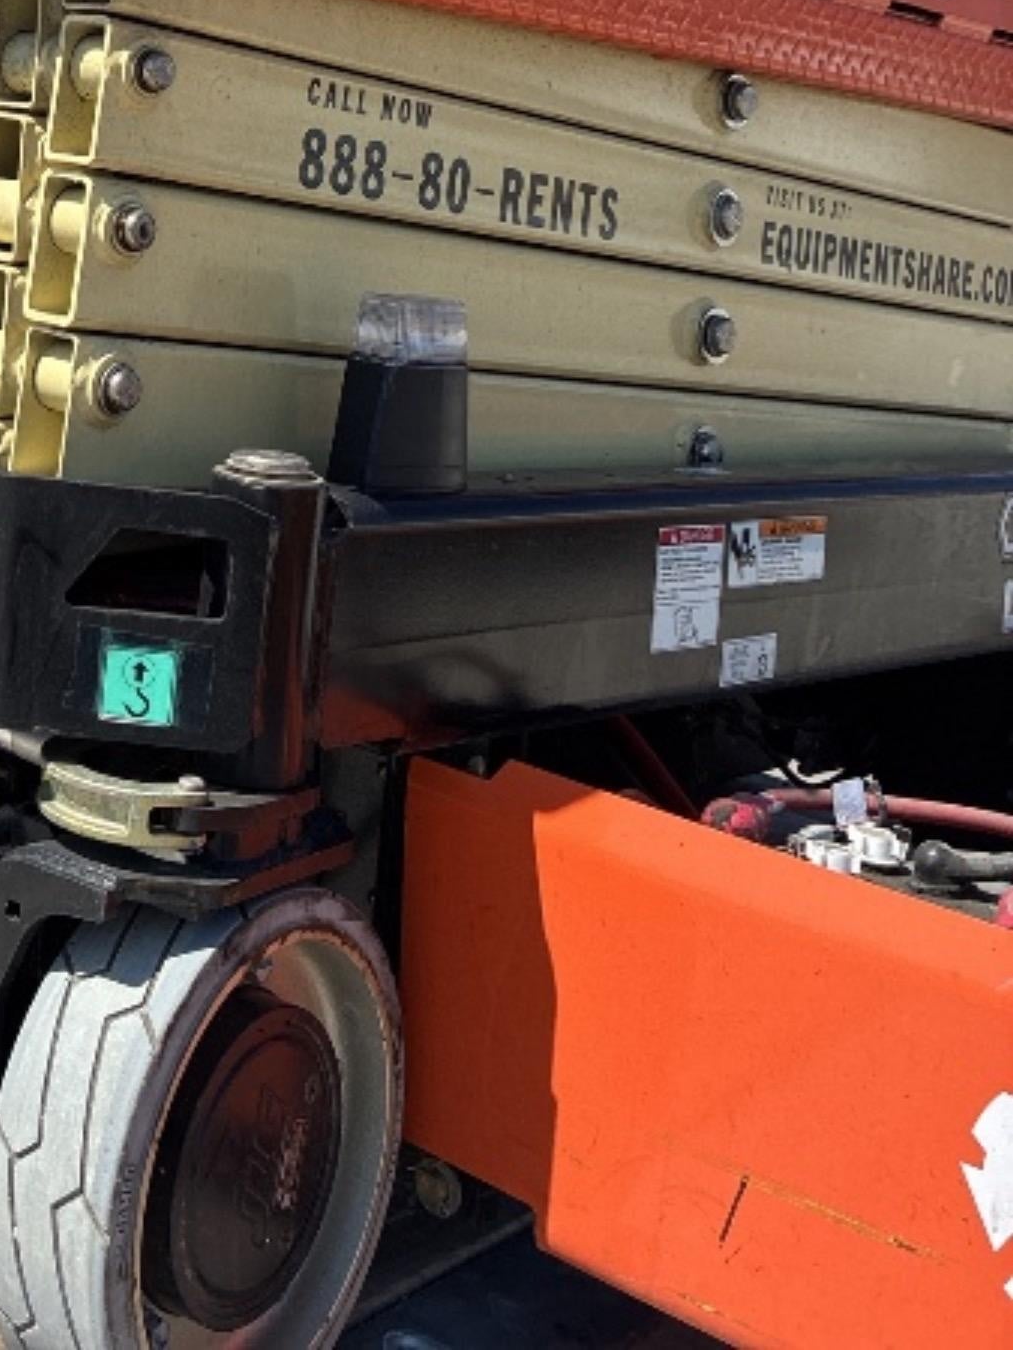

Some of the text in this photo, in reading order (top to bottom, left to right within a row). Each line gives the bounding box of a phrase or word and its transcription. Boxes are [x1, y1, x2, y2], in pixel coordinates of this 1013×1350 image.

[307, 77, 434, 129] CALL NOW
[299, 128, 619, 240] 888-80-RENTS
